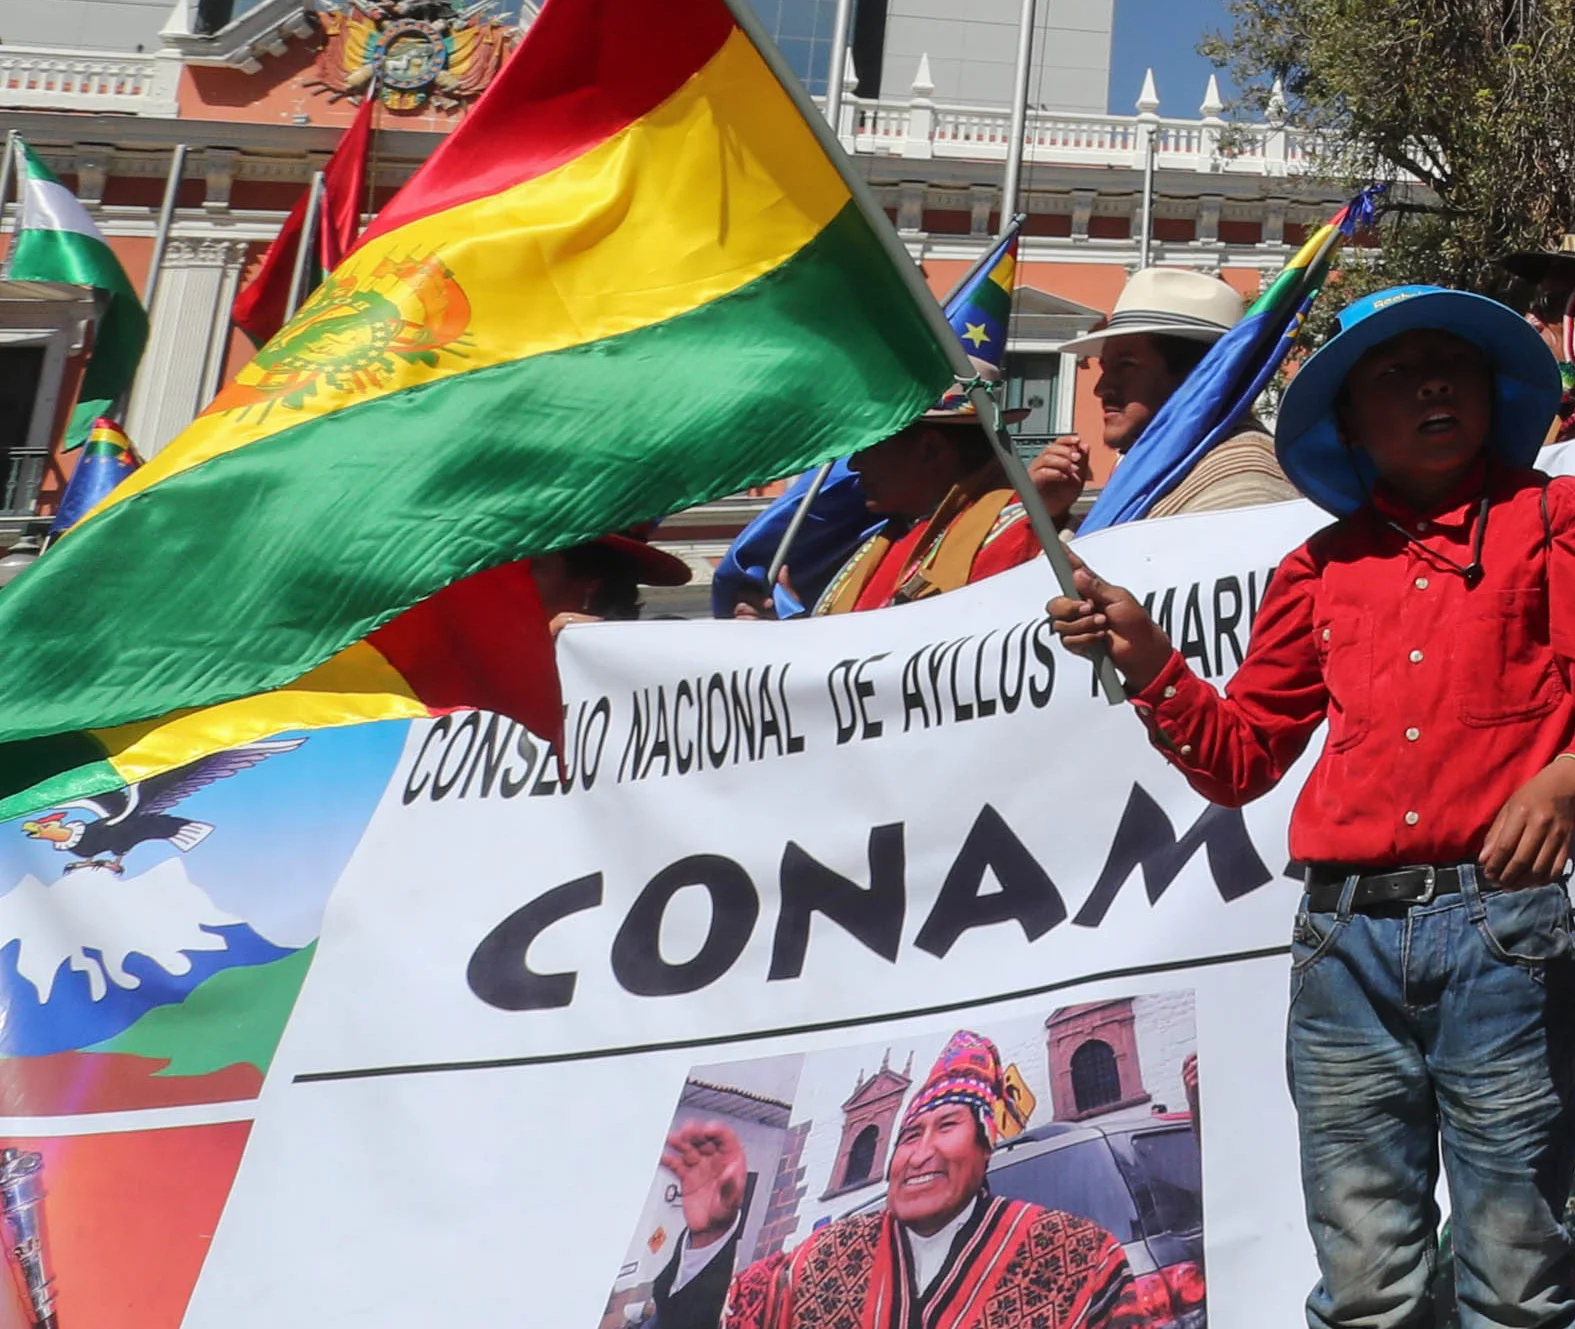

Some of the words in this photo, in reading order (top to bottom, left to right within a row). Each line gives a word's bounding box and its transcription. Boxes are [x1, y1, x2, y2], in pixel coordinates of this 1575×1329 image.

[616, 662, 806, 784] NACIONAL
[827, 651, 893, 746] DE
[901, 616, 1056, 734] AYLLUS
[466, 781, 1306, 1012] CONAM
